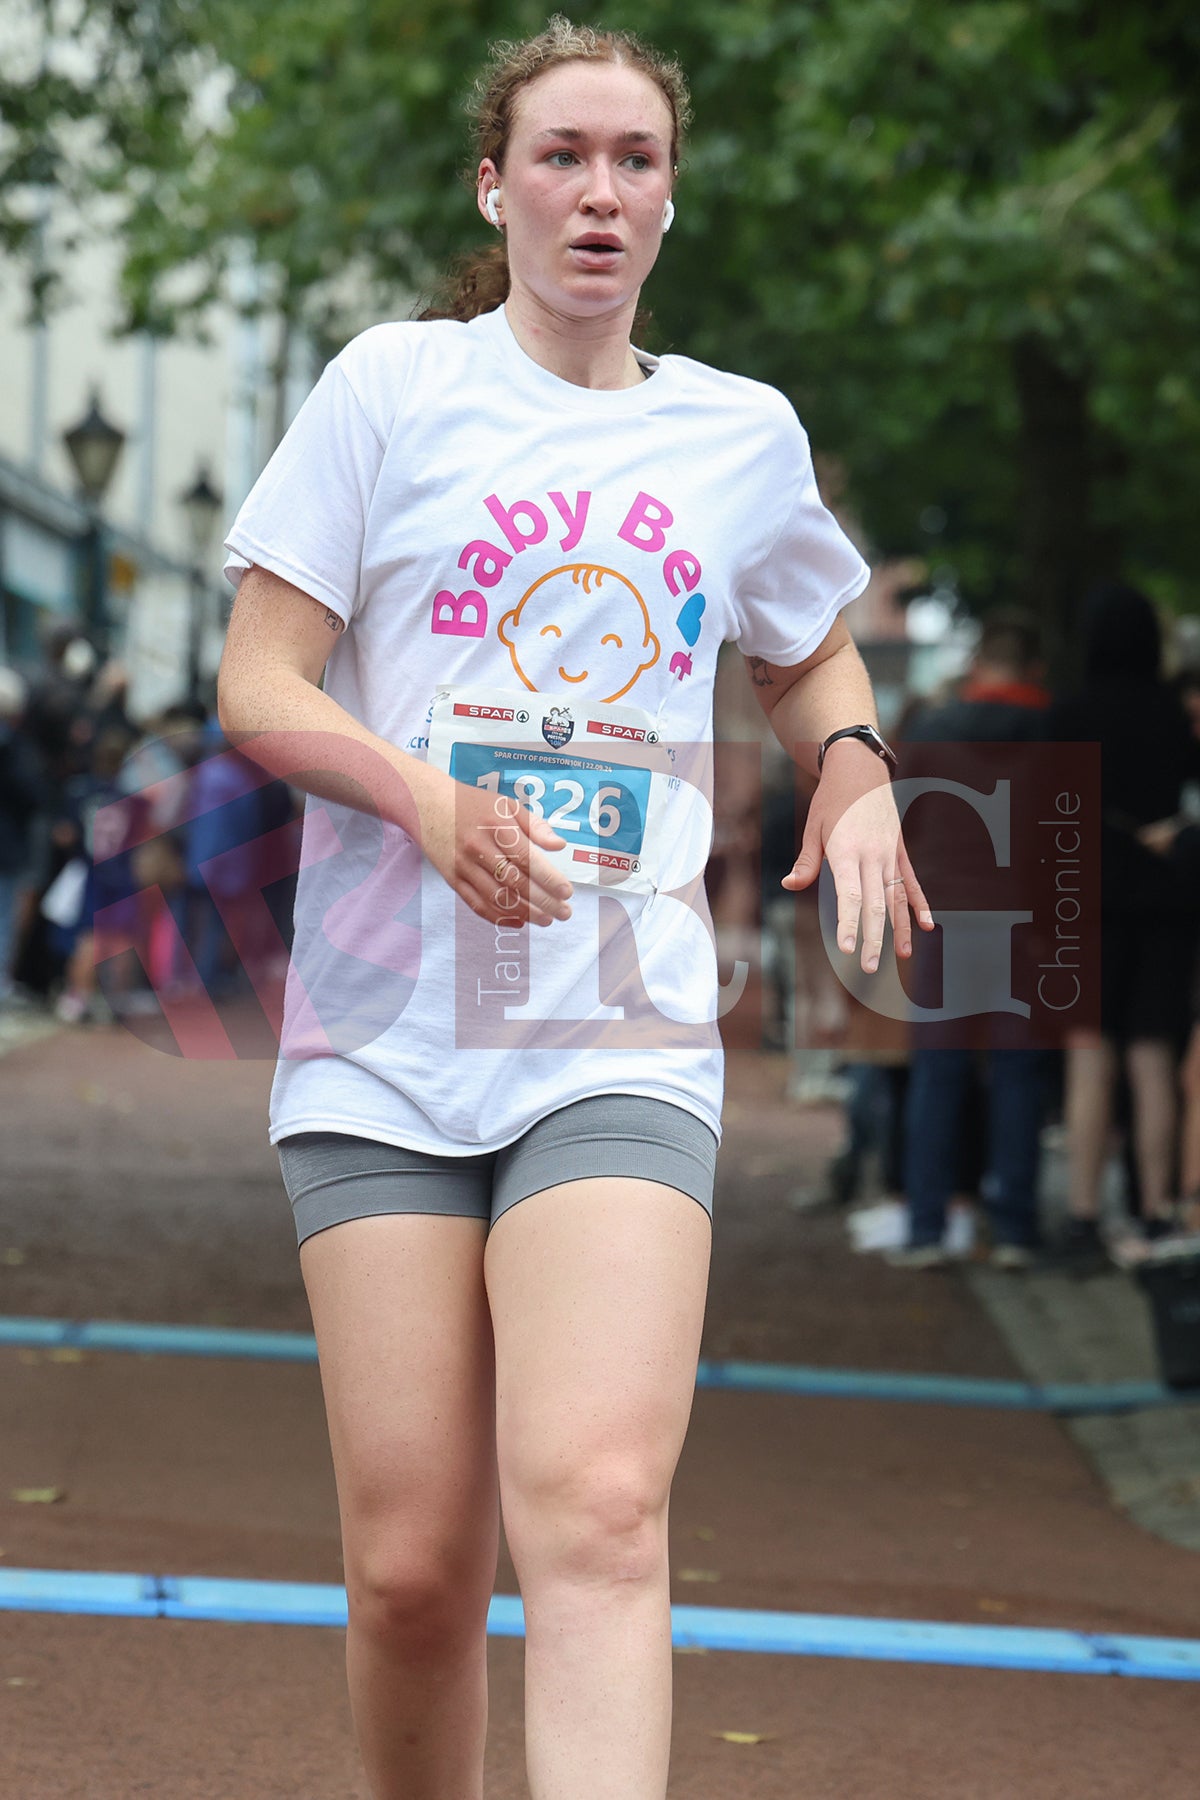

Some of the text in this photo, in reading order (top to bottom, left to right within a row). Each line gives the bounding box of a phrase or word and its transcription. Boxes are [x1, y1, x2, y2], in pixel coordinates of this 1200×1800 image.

[431, 490, 592, 639] Baby
[468, 706, 514, 720] SPAR
[601, 724, 645, 741] SPAR
[494, 750, 512, 760] SPAR
[512, 752, 528, 761] CITY
[585, 763, 614, 774] 22.09.24
[588, 853, 630, 871] SPAR
